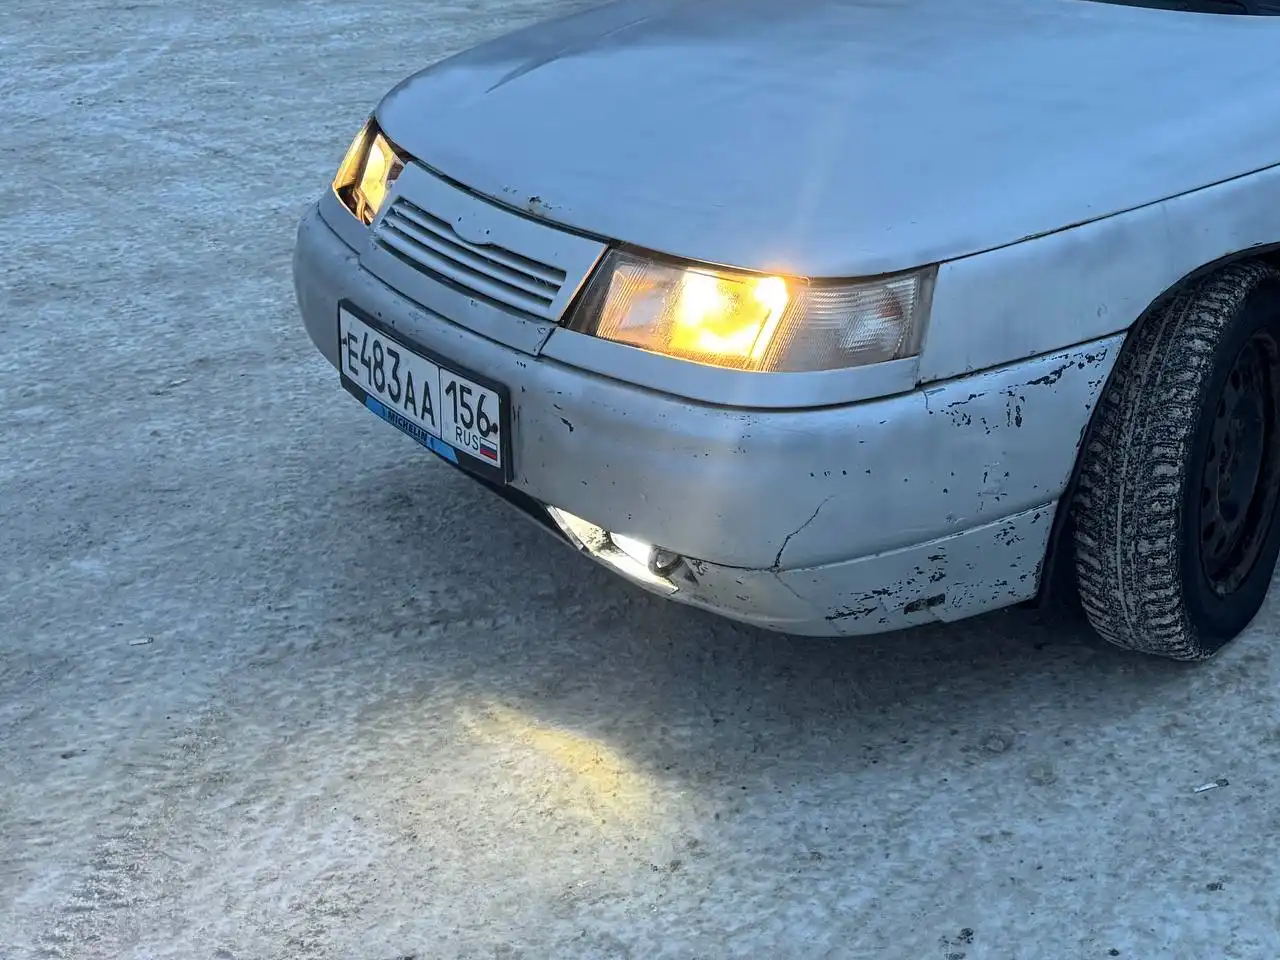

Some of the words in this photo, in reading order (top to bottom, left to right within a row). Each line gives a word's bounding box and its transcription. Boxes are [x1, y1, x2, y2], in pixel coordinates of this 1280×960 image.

[347, 332, 436, 427] Е483АА
[445, 380, 491, 438] 156
[387, 410, 428, 442] MICHELIN
[456, 426, 479, 451] RUS
